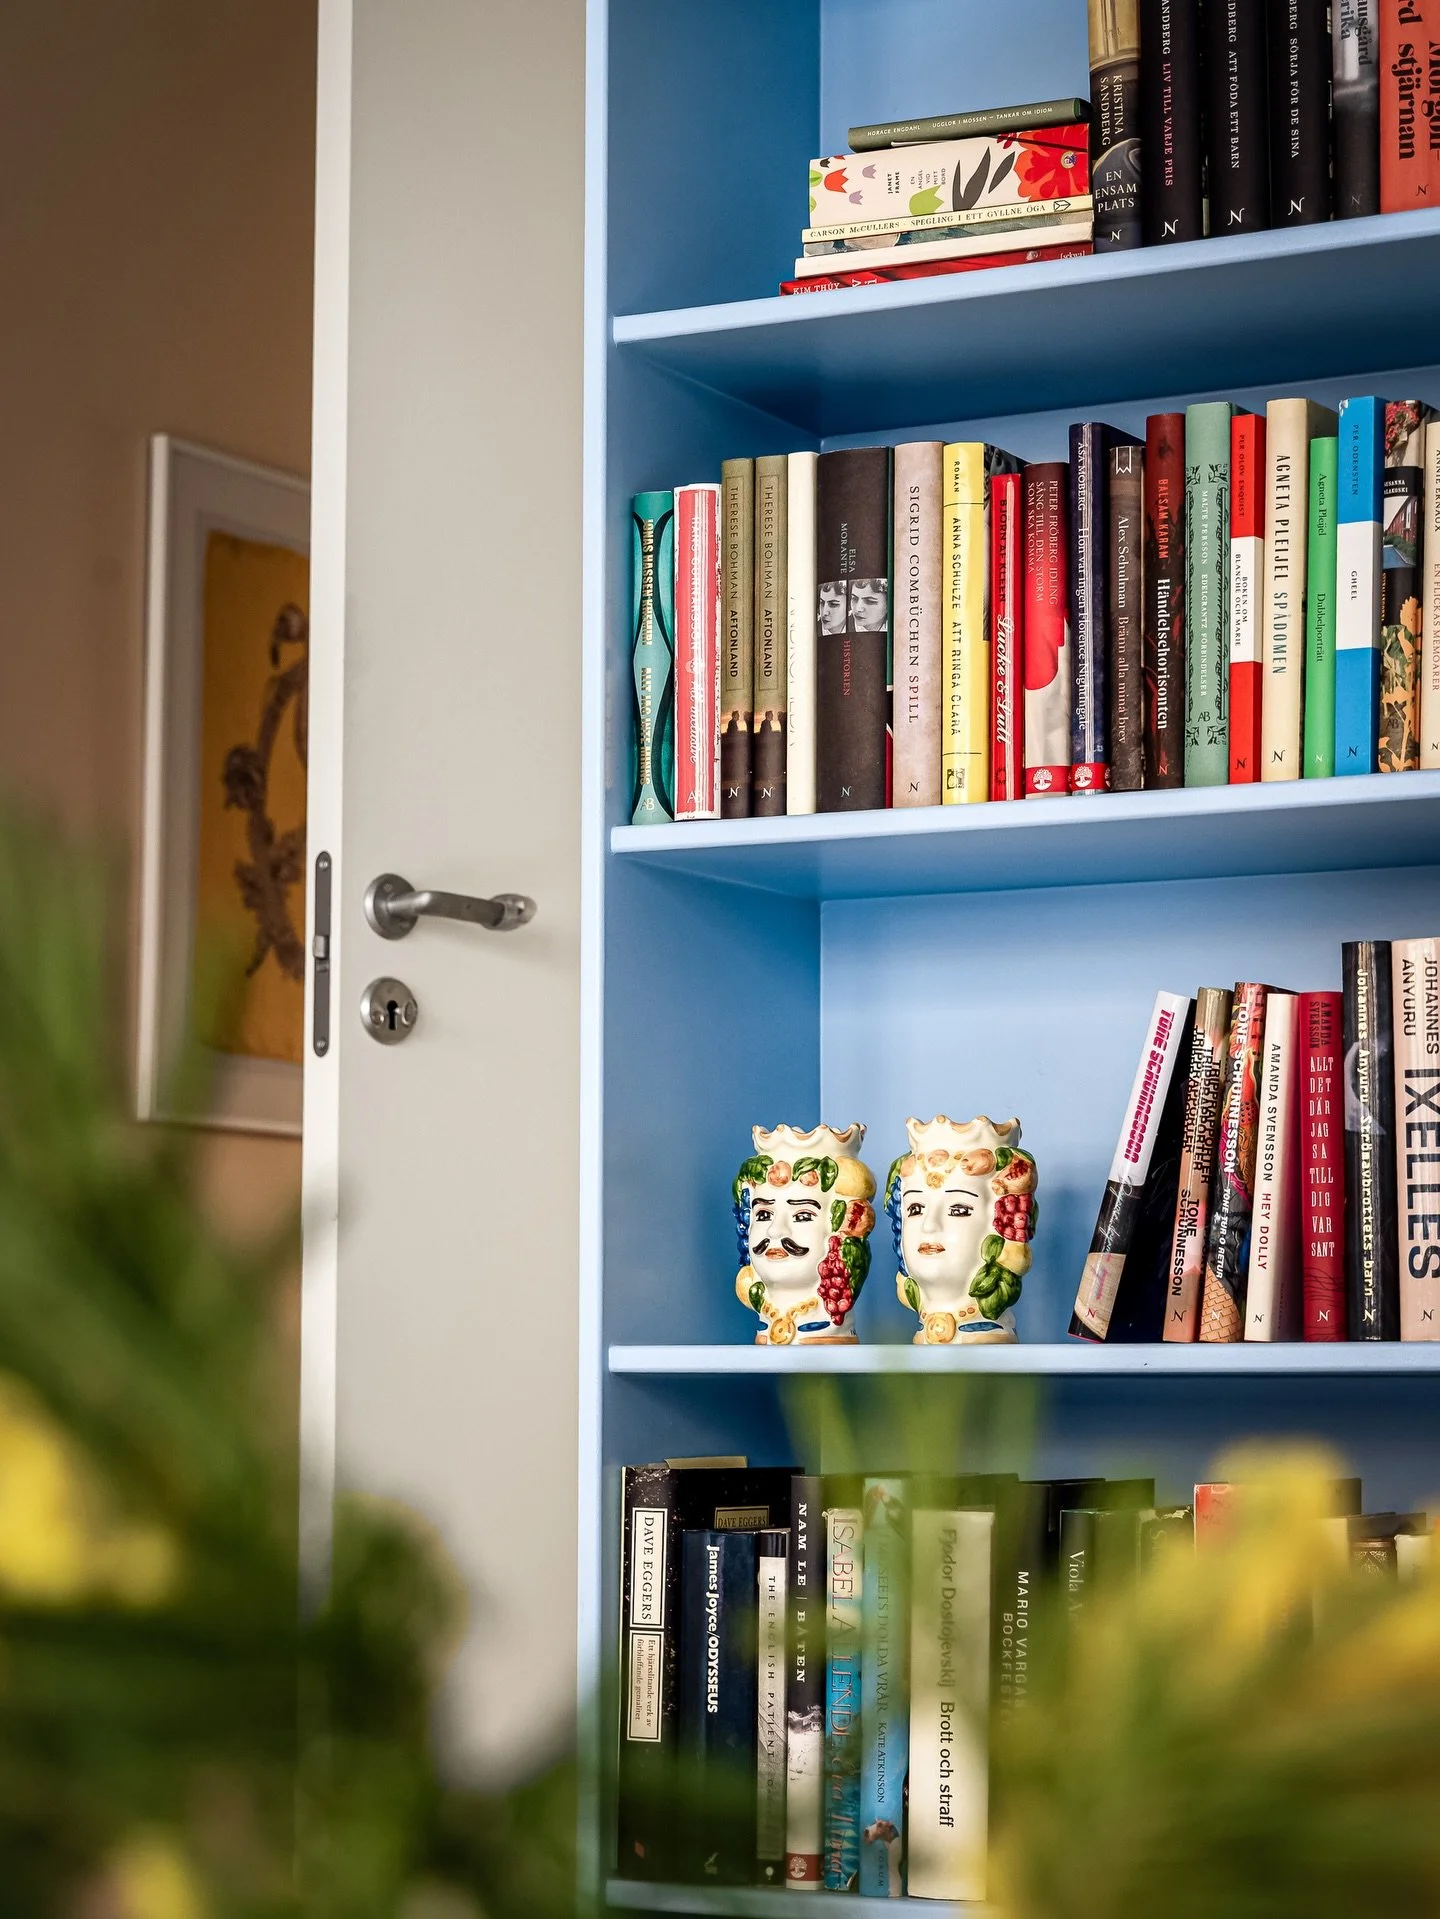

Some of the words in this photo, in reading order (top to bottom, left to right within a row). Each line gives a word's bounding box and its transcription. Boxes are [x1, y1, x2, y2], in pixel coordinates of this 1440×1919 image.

[1162, 63, 1172, 82] LIV
[1228, 50, 1238, 72] ATT
[1290, 38, 1300, 76] SÖRJA
[1112, 74, 1124, 135] KRISTINA
[1163, 88, 1172, 114] TILL
[1228, 76, 1240, 108] FÖDA
[1290, 81, 1300, 104] FÖR
[1391, 43, 1422, 160] stjärnan
[866, 126, 891, 136] HORACE
[892, 123, 922, 134] ENGDAHL
[932, 120, 956, 128] UGGLOR
[962, 115, 988, 124] MOSSEN
[996, 111, 1020, 120] TANKAR
[1034, 106, 1054, 115] IDIOM
[1100, 76, 1111, 146] SANDBERG
[1230, 111, 1239, 134] ETT
[1290, 108, 1299, 125] DE
[1164, 118, 1173, 154] VARJE
[1230, 136, 1240, 169] BARN
[1290, 129, 1300, 158] SINA
[1106, 170, 1122, 182] EN
[1164, 159, 1174, 186] PRIS
[1094, 184, 1137, 199] ENSAM
[1098, 198, 1135, 212] PLATS
[810, 226, 846, 238] CARSON
[850, 220, 900, 234] McCULLERS
[910, 214, 954, 228] SPEGLING
[966, 212, 982, 220] ETT
[986, 207, 1024, 218] GYLLNE
[1026, 203, 1046, 214] ÖGA
[1352, 424, 1360, 441] PER
[1078, 442, 1089, 464] ÅSA
[1352, 446, 1360, 496] ODENSTEN
[1036, 482, 1046, 510] SÅNG
[1049, 480, 1058, 511] PETER
[1077, 466, 1086, 512] MOBERG
[1158, 478, 1168, 520] BALSAM
[1275, 455, 1290, 510] AGNETA
[1317, 473, 1328, 506] Agneta
[730, 486, 738, 538] THERESE
[764, 485, 774, 538] THERESE
[909, 486, 920, 546] SIGRID
[1200, 490, 1208, 520] MALTE
[1316, 508, 1328, 537] Pleijel
[642, 518, 654, 553] JONAS
[952, 518, 962, 550] ANNA
[1036, 514, 1044, 538] TILL
[1049, 514, 1060, 563] FRÖBERG
[1078, 526, 1089, 554] Hon
[1118, 515, 1129, 542] Alex
[1158, 524, 1168, 559] KARAM
[840, 523, 848, 574] MORANTE
[848, 548, 856, 573] ELSA
[1036, 539, 1044, 564] DEN
[1078, 556, 1087, 574] var
[1274, 519, 1290, 582] PLEIJEL
[642, 554, 654, 596] HASSEN
[730, 543, 738, 600] BOHMAN
[764, 542, 774, 599] BOHMAN
[952, 554, 961, 609] SCHULZE
[1036, 566, 1044, 602] STORM
[1049, 568, 1058, 605] IDLING
[1118, 546, 1129, 608] Schulman
[1234, 554, 1242, 594] BLANCHE
[1350, 570, 1358, 600] GHEEL
[909, 554, 922, 666] COMBÜCHEN
[1076, 577, 1088, 608] ingen
[1234, 596, 1242, 616] OCH
[952, 622, 962, 644] ATT
[1234, 619, 1242, 647] MARIE
[1242, 608, 1248, 623] OM
[1272, 592, 1292, 674] SPÅDOMEN
[1316, 592, 1326, 662] Dubbelporträtt
[730, 610, 738, 678] AFTONLAND
[764, 609, 772, 678] AFTONLAND
[1078, 612, 1089, 660] Florence
[1118, 616, 1129, 654] Bränn
[842, 640, 850, 696] HISTORIEN
[951, 649, 961, 688] RINGA
[1118, 657, 1129, 678] alla
[1157, 578, 1170, 730] Händelsehorisonten
[1432, 630, 1440, 691] MEMOARER
[908, 676, 919, 724] SPILL
[950, 694, 962, 736] CLARA
[1076, 663, 1089, 730] Nightingale
[1118, 682, 1128, 713] mina
[1118, 716, 1129, 744] brev
[1357, 968, 1368, 1040] Johannes
[1402, 958, 1416, 1036] ANYURU
[1424, 957, 1440, 1054] JOHANNES
[1235, 1000, 1249, 1044] TONE
[1308, 1001, 1320, 1049] SVENSSON
[1268, 1044, 1281, 1102] AMANDA
[1310, 1056, 1334, 1072] ALLT
[1357, 1049, 1371, 1102] Anyuru
[1310, 1078, 1331, 1094] DET
[1224, 1046, 1246, 1174] SCHUNNESSON
[1309, 1096, 1331, 1116] DÄR
[1263, 1106, 1277, 1182] SVENSSON
[1310, 1122, 1330, 1138] JAG
[1312, 1144, 1328, 1159] SA
[1309, 1167, 1334, 1184] TILL
[1360, 1114, 1374, 1250] Strömavbrottets
[1404, 1068, 1440, 1278] IXELLES
[1221, 1188, 1231, 1213] TONE
[1260, 1192, 1272, 1220] HEY
[1311, 1190, 1330, 1207] DIG
[1186, 1198, 1200, 1237] TONE
[1312, 1216, 1333, 1234] VAR
[1172, 1188, 1190, 1296] SCHUNNESSON
[1258, 1226, 1269, 1270] DOLLY
[1311, 1242, 1335, 1257] SANT
[1215, 1246, 1225, 1279] RETUR
[1364, 1260, 1374, 1296] barn
[643, 1516, 655, 1556] DAVE
[798, 1502, 808, 1550] NAM
[706, 1544, 720, 1590] James
[798, 1560, 807, 1586] LE
[832, 1517, 858, 1610] ISABEL
[938, 1528, 957, 1582] Fjodor
[1068, 1550, 1085, 1592] Viola
[642, 1560, 654, 1620] EGGERS
[768, 1576, 776, 1601] THE
[1016, 1570, 1029, 1629] MARIO
[648, 1640, 656, 1650] Ett
[706, 1592, 720, 1713] Joyce/ODYSSEUS
[936, 1586, 957, 1688] Dostojevskij
[636, 1638, 645, 1684] förbluffande
[646, 1653, 656, 1698] hjärtslitande
[634, 1686, 643, 1720] genialitet
[646, 1700, 654, 1716] verk
[646, 1718, 652, 1728] av
[767, 1692, 775, 1758] PATIENT
[877, 1722, 887, 1748] KATE
[940, 1701, 955, 1744] Brott
[877, 1749, 886, 1804] ATKINSON
[940, 1748, 954, 1778] och
[939, 1784, 954, 1828] straff
